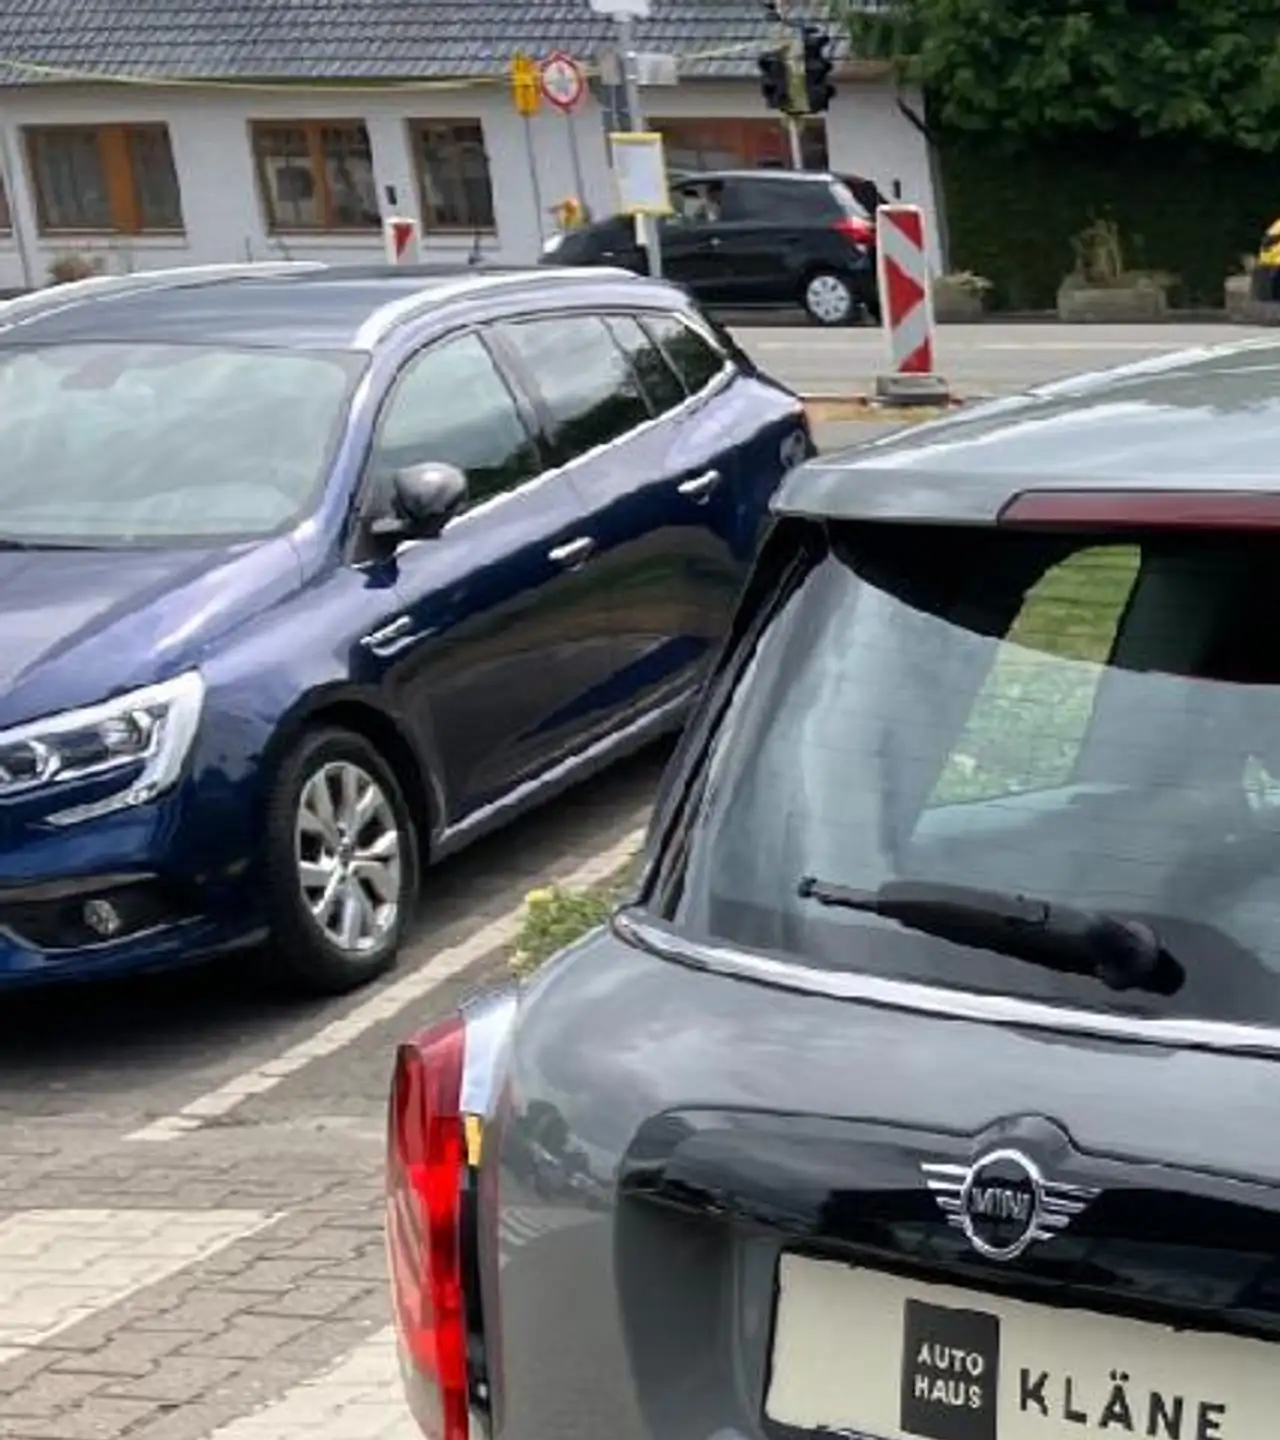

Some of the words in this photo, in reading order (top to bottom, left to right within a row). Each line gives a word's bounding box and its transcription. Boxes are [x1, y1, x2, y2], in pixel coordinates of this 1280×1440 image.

[970, 1187, 1031, 1221] MINI
[917, 1342, 984, 1377] AUTO
[914, 1374, 983, 1409] HAUS
